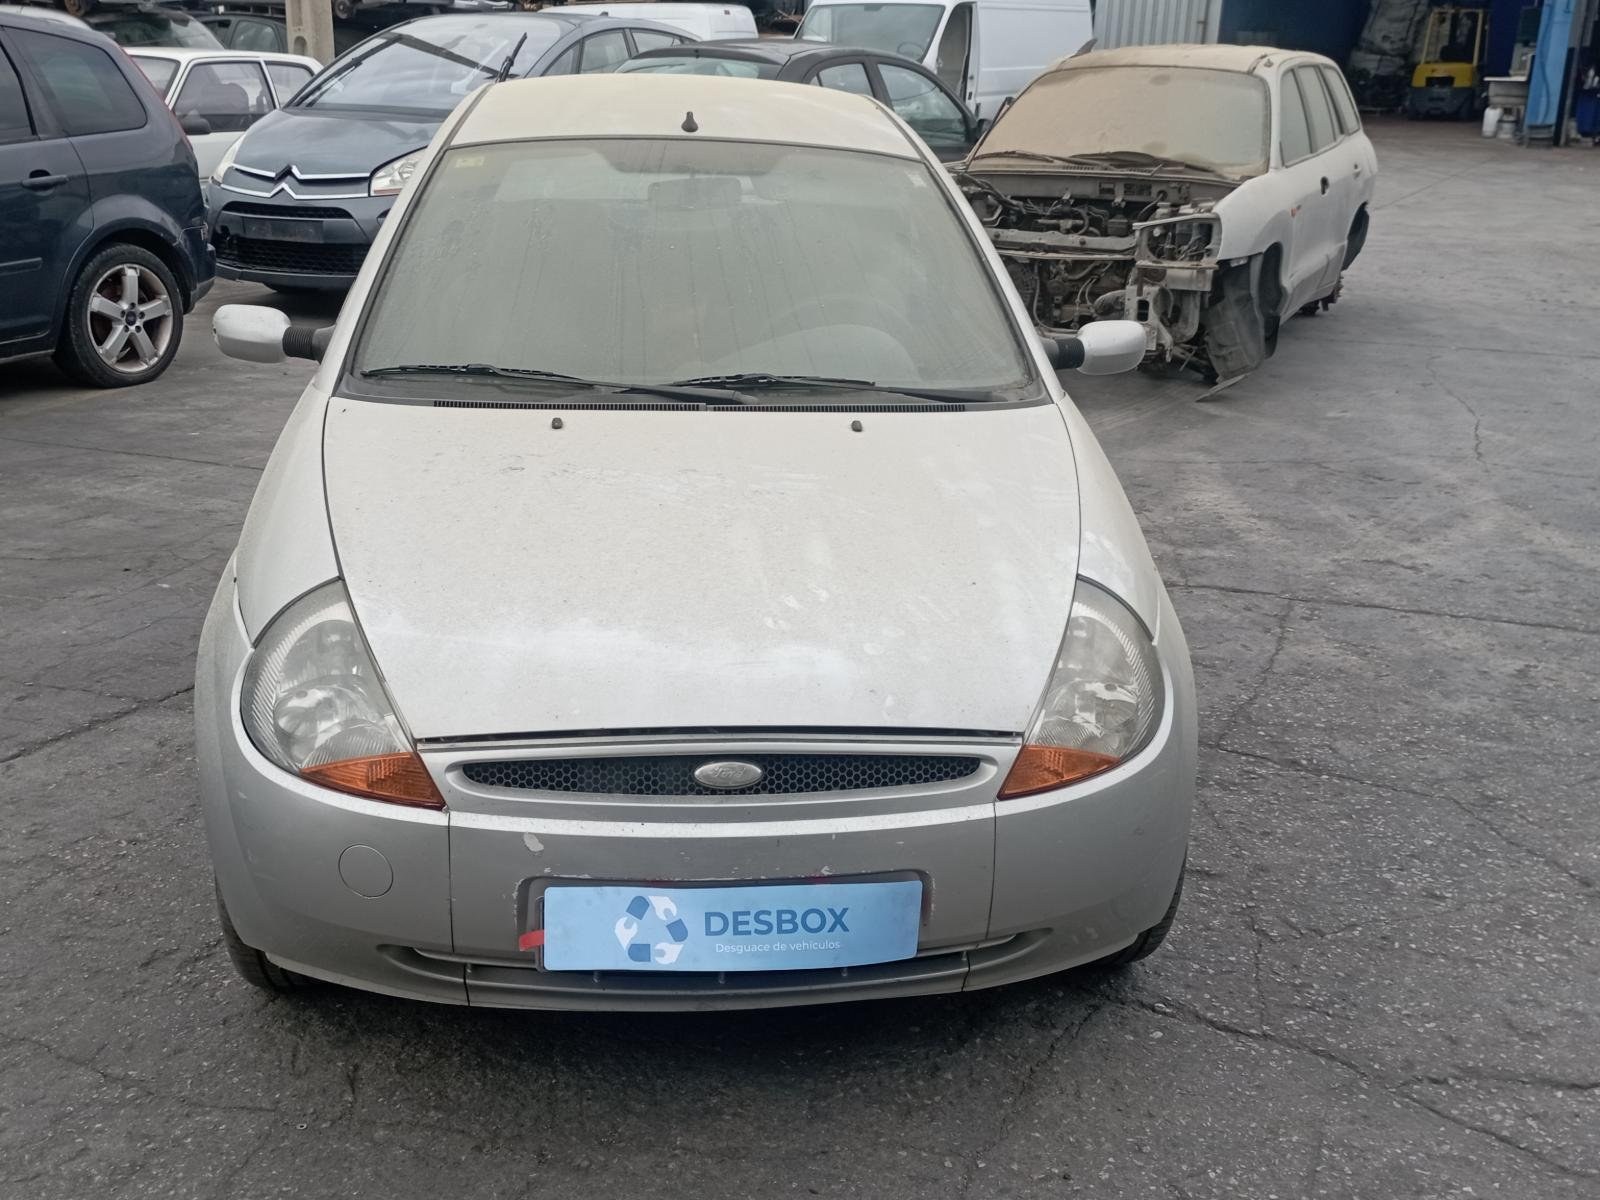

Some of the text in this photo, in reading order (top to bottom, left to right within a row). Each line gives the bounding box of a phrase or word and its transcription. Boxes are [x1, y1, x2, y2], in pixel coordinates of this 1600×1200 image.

[704, 907, 849, 936] DESBOX
[715, 943, 770, 954] Desguace
[773, 941, 787, 951] de
